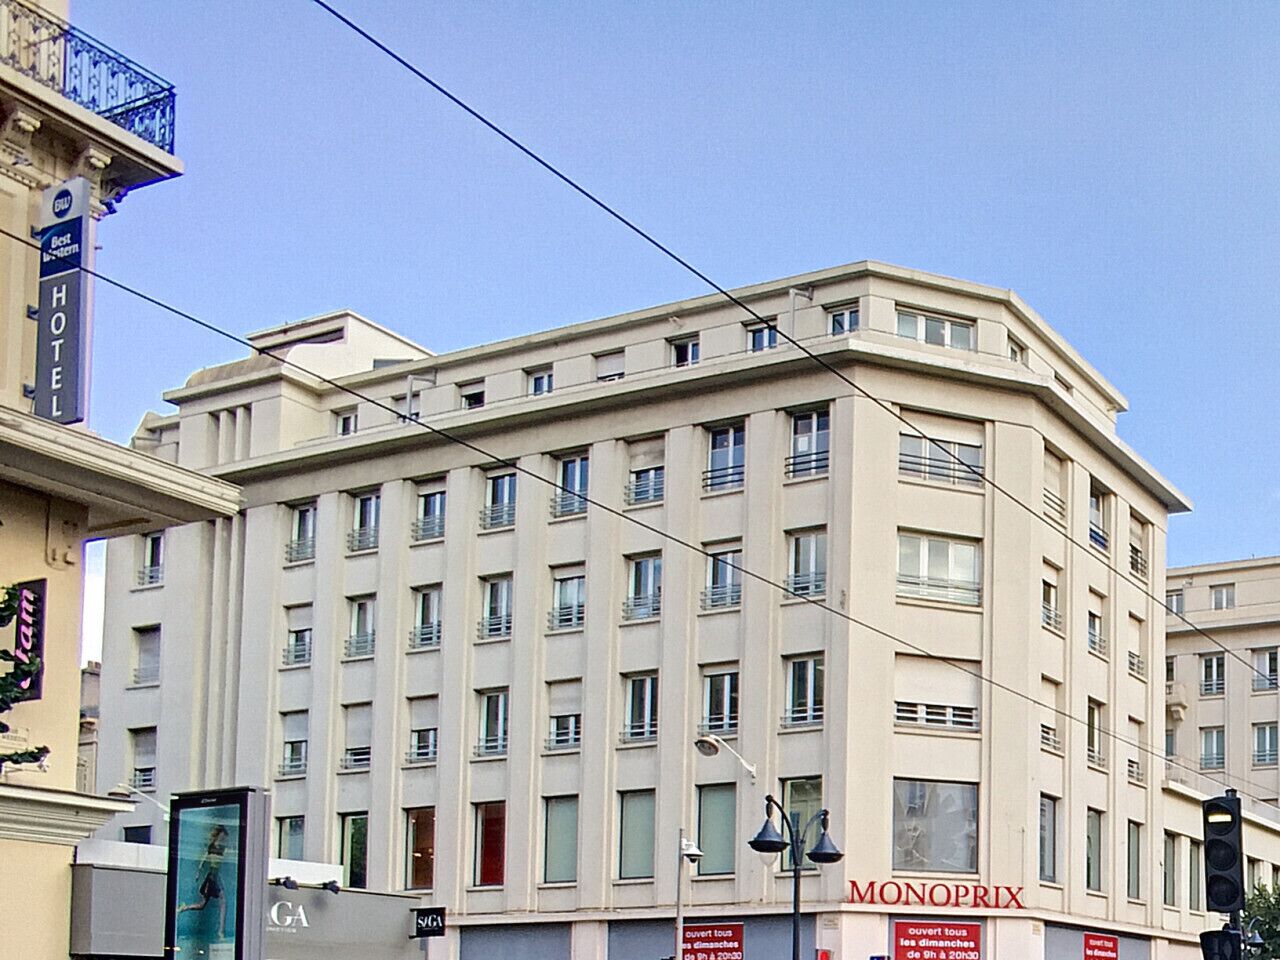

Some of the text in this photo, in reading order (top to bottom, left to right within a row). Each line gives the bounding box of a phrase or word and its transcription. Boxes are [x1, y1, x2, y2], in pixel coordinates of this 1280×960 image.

[51, 233, 72, 248] Best
[51, 284, 67, 417] HOTEL
[849, 880, 1026, 909] MONOPRIX
[685, 929, 733, 938] ouvert tous
[908, 927, 967, 937] ouvert tous
[693, 940, 739, 949] dimanches
[900, 938, 975, 948] les dimanches
[684, 953, 695, 960] de
[697, 952, 708, 960] 9h
[907, 951, 979, 960] de 9h à 20h30
